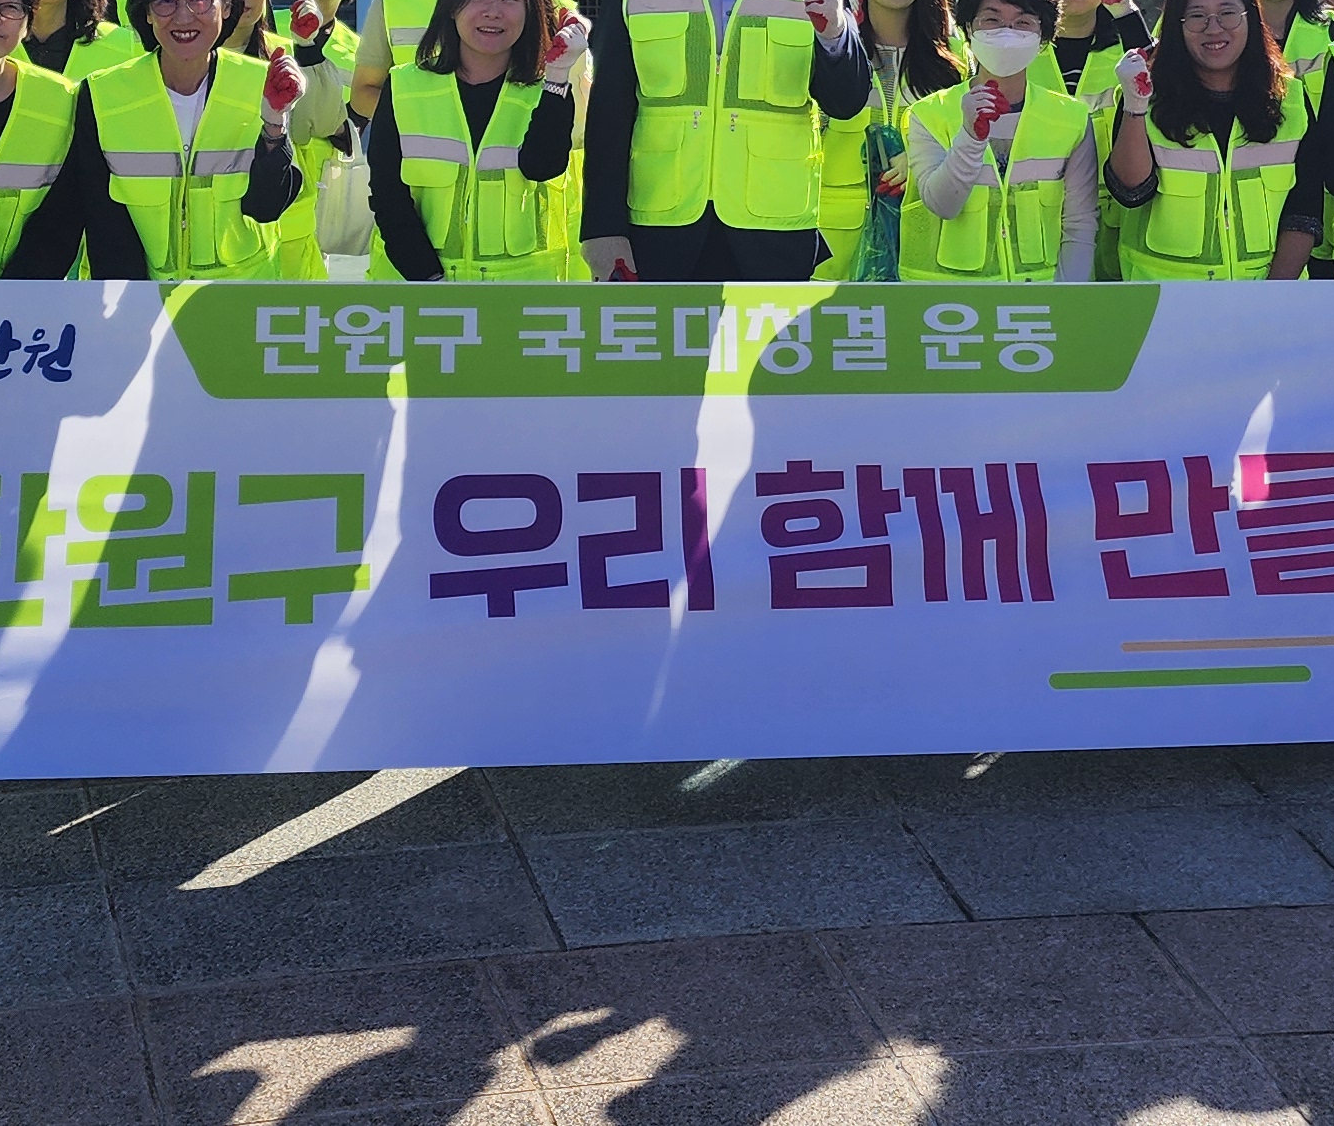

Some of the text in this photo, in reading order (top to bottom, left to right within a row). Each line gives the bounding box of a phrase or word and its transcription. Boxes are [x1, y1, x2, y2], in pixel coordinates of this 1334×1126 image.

[255, 302, 1058, 375] 단원구 국토대청결 운동
[429, 466, 716, 619] 우리
[754, 459, 1055, 610] 함께
